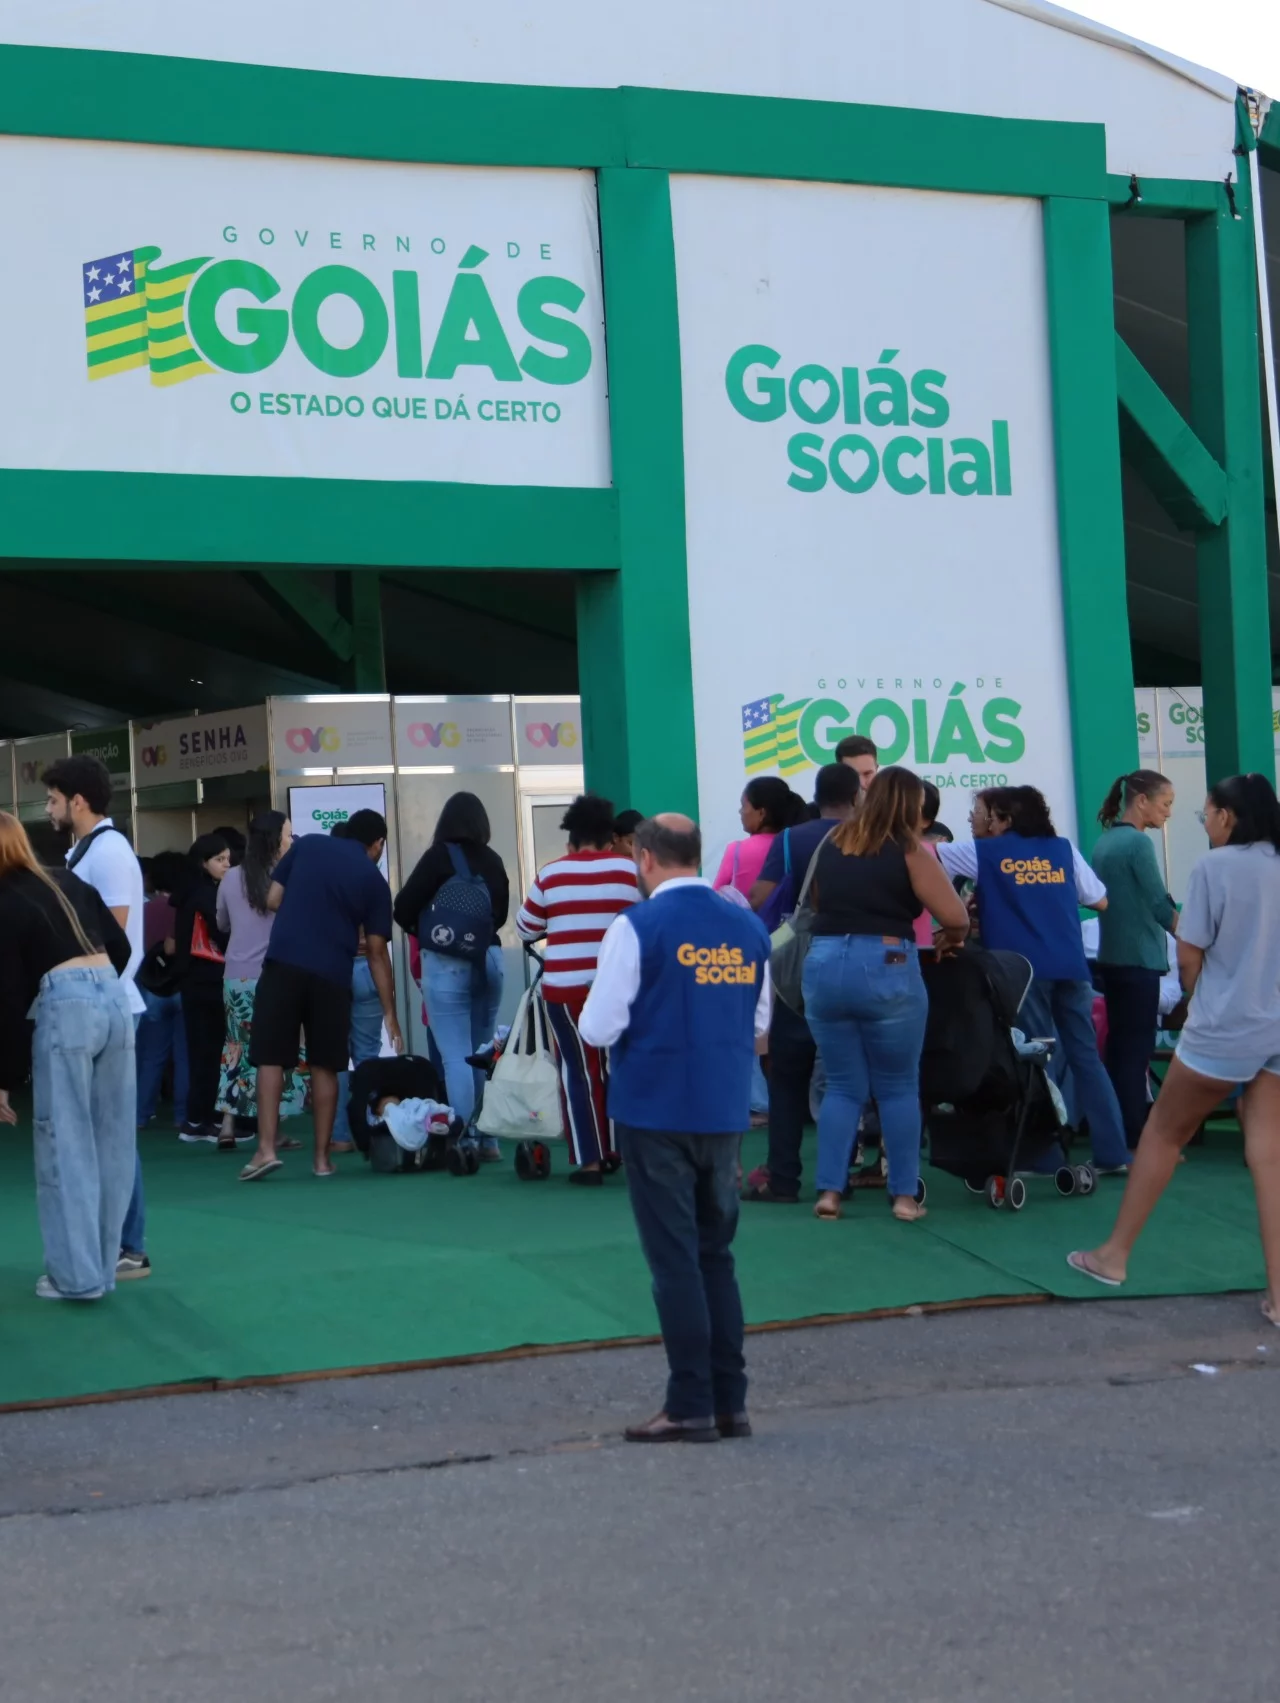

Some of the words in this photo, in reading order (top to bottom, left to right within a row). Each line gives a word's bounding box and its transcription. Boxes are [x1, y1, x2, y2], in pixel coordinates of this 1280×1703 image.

[222, 225, 446, 255] GOVERNO
[506, 241, 552, 260] DE
[188, 244, 592, 385] GOIÁS
[725, 344, 950, 428] Goiás
[230, 391, 251, 414] O
[259, 392, 364, 417] ESTADO
[372, 396, 427, 420] QUE
[435, 393, 470, 421] DÁ
[477, 399, 562, 423] CERTO
[786, 419, 1012, 496] social
[818, 677, 942, 689] GOVERNO
[977, 677, 1002, 688] DE
[798, 681, 1025, 766] GOIÁS
[179, 725, 247, 755] SENHA
[935, 774, 957, 788] DÁ
[960, 774, 1008, 788] CERTO
[1000, 856, 1052, 874] Goiás
[1014, 867, 1065, 885] social
[677, 943, 744, 966] Goiás
[695, 961, 756, 985] social
